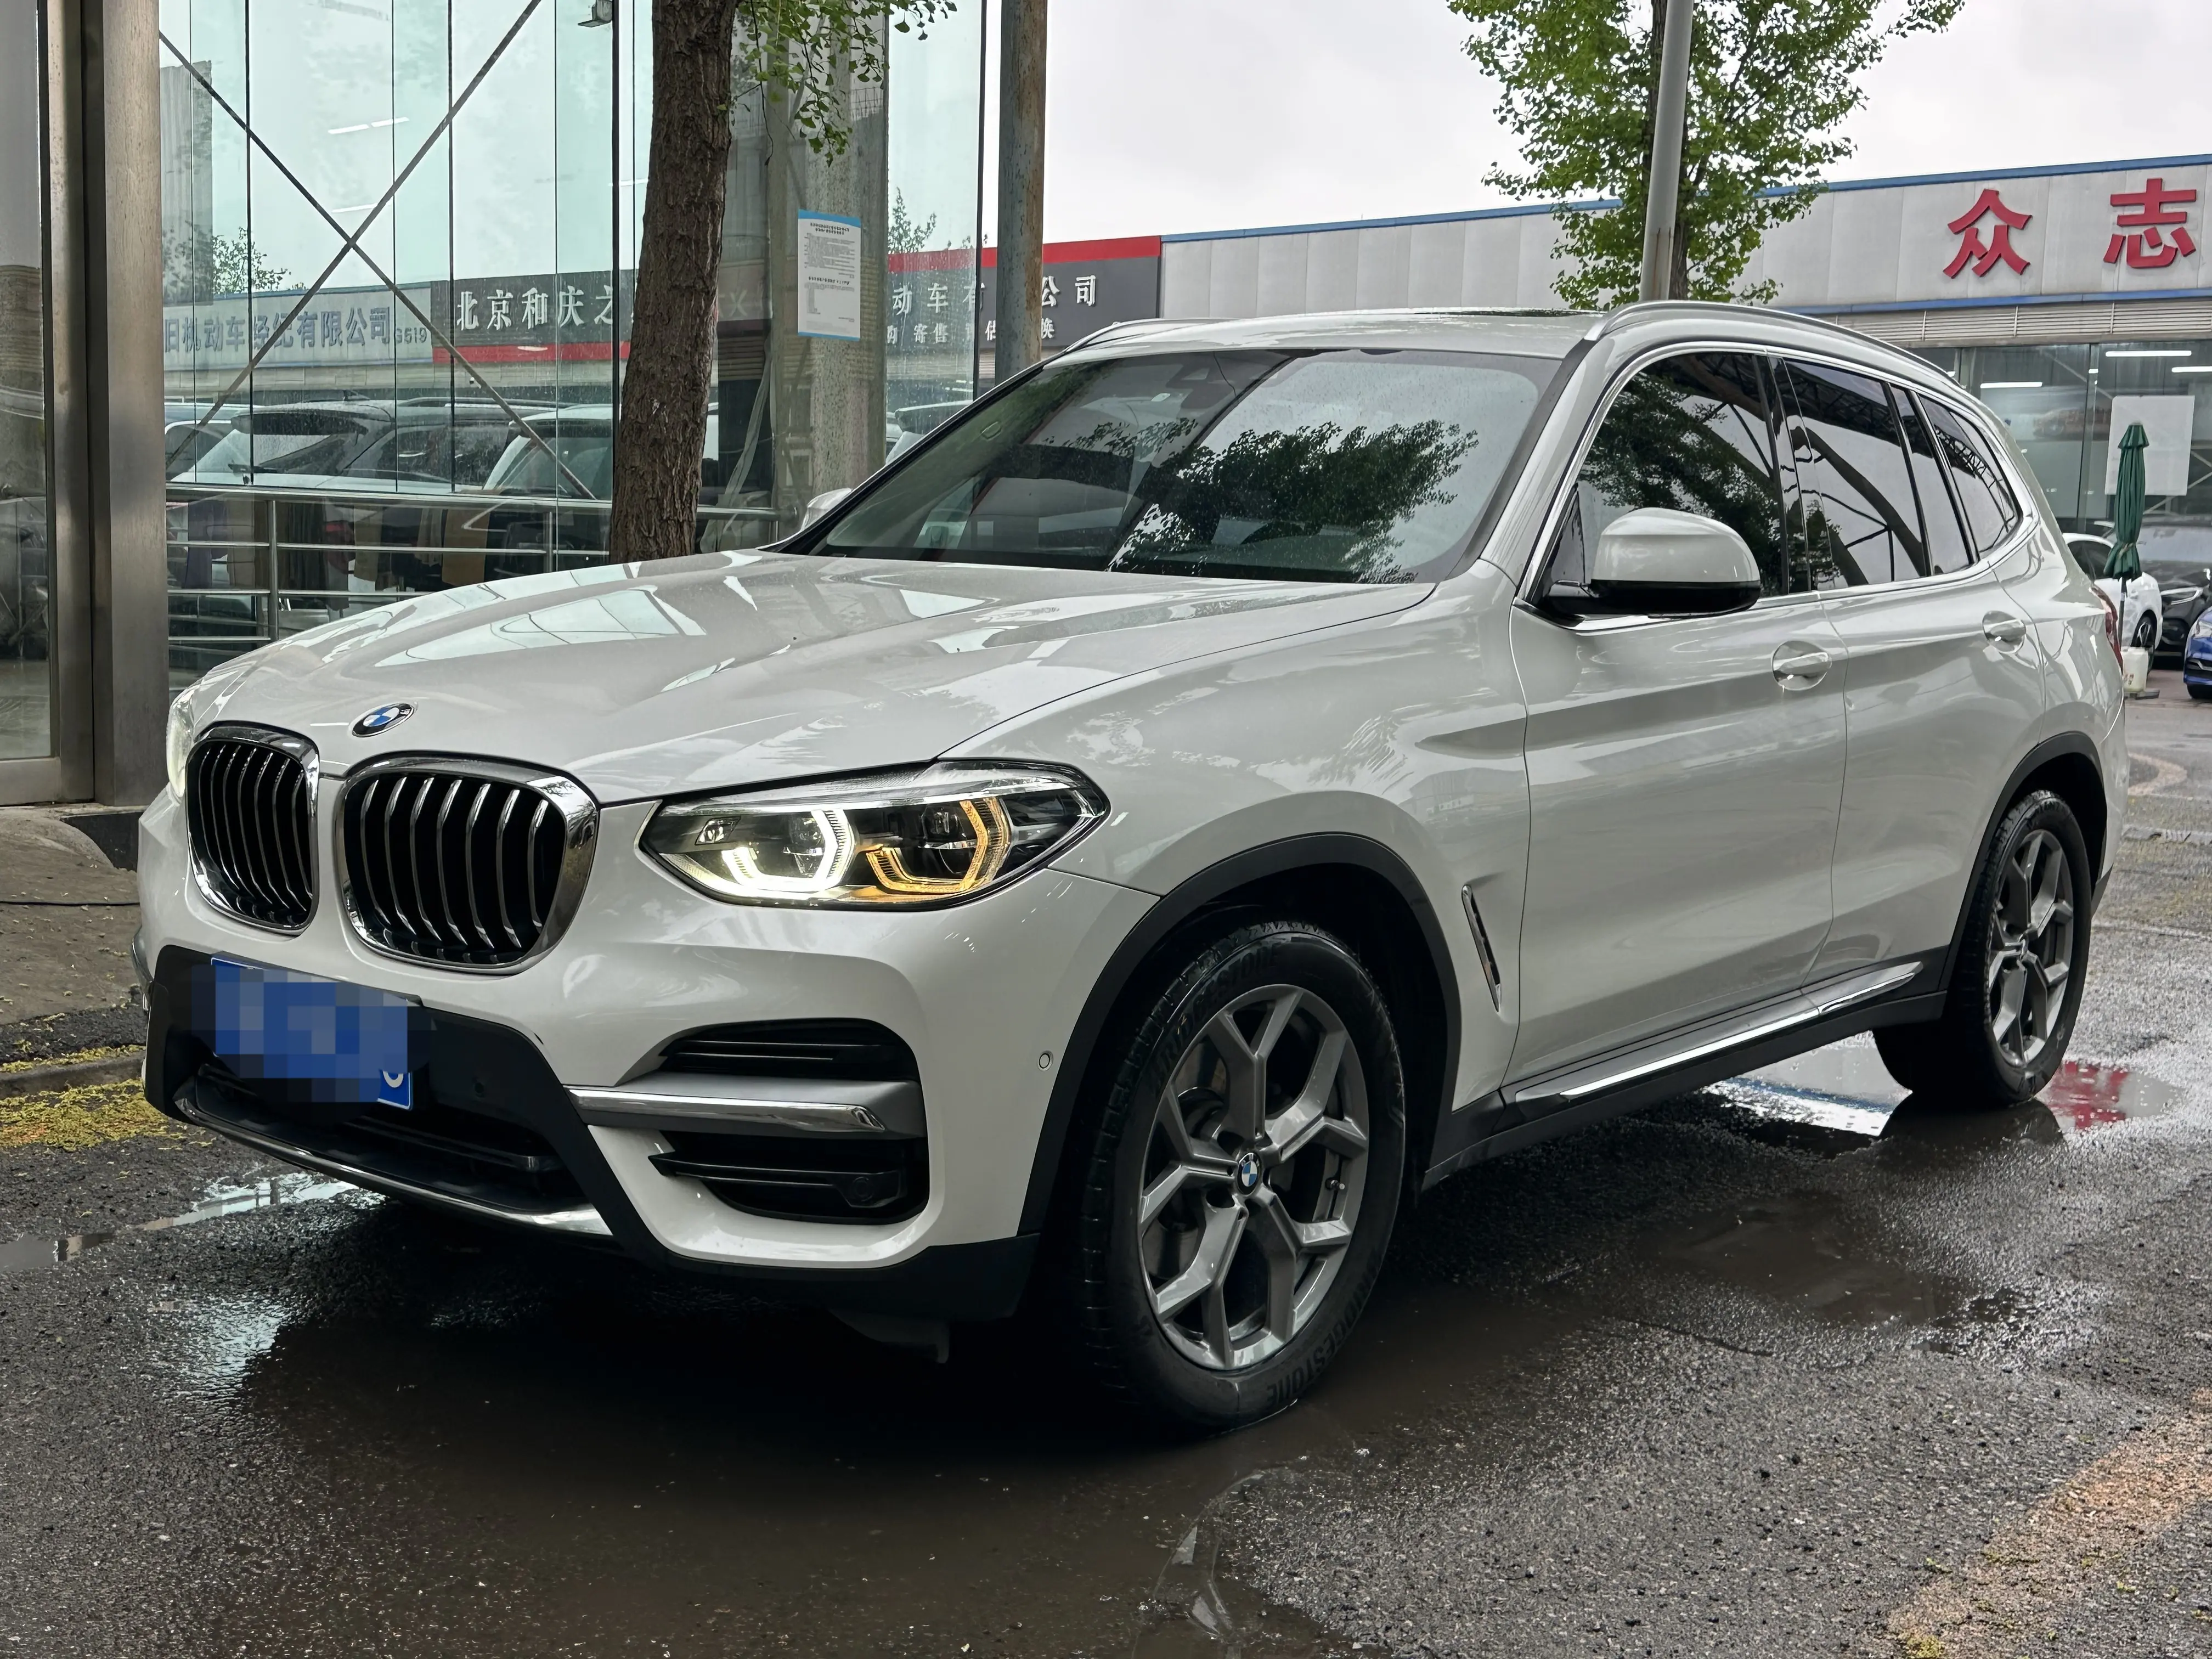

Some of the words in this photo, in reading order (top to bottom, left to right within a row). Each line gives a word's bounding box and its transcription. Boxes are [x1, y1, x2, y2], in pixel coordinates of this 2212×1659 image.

[1943, 177, 2197, 279] 众志
[456, 285, 613, 331] 北京和庆之
